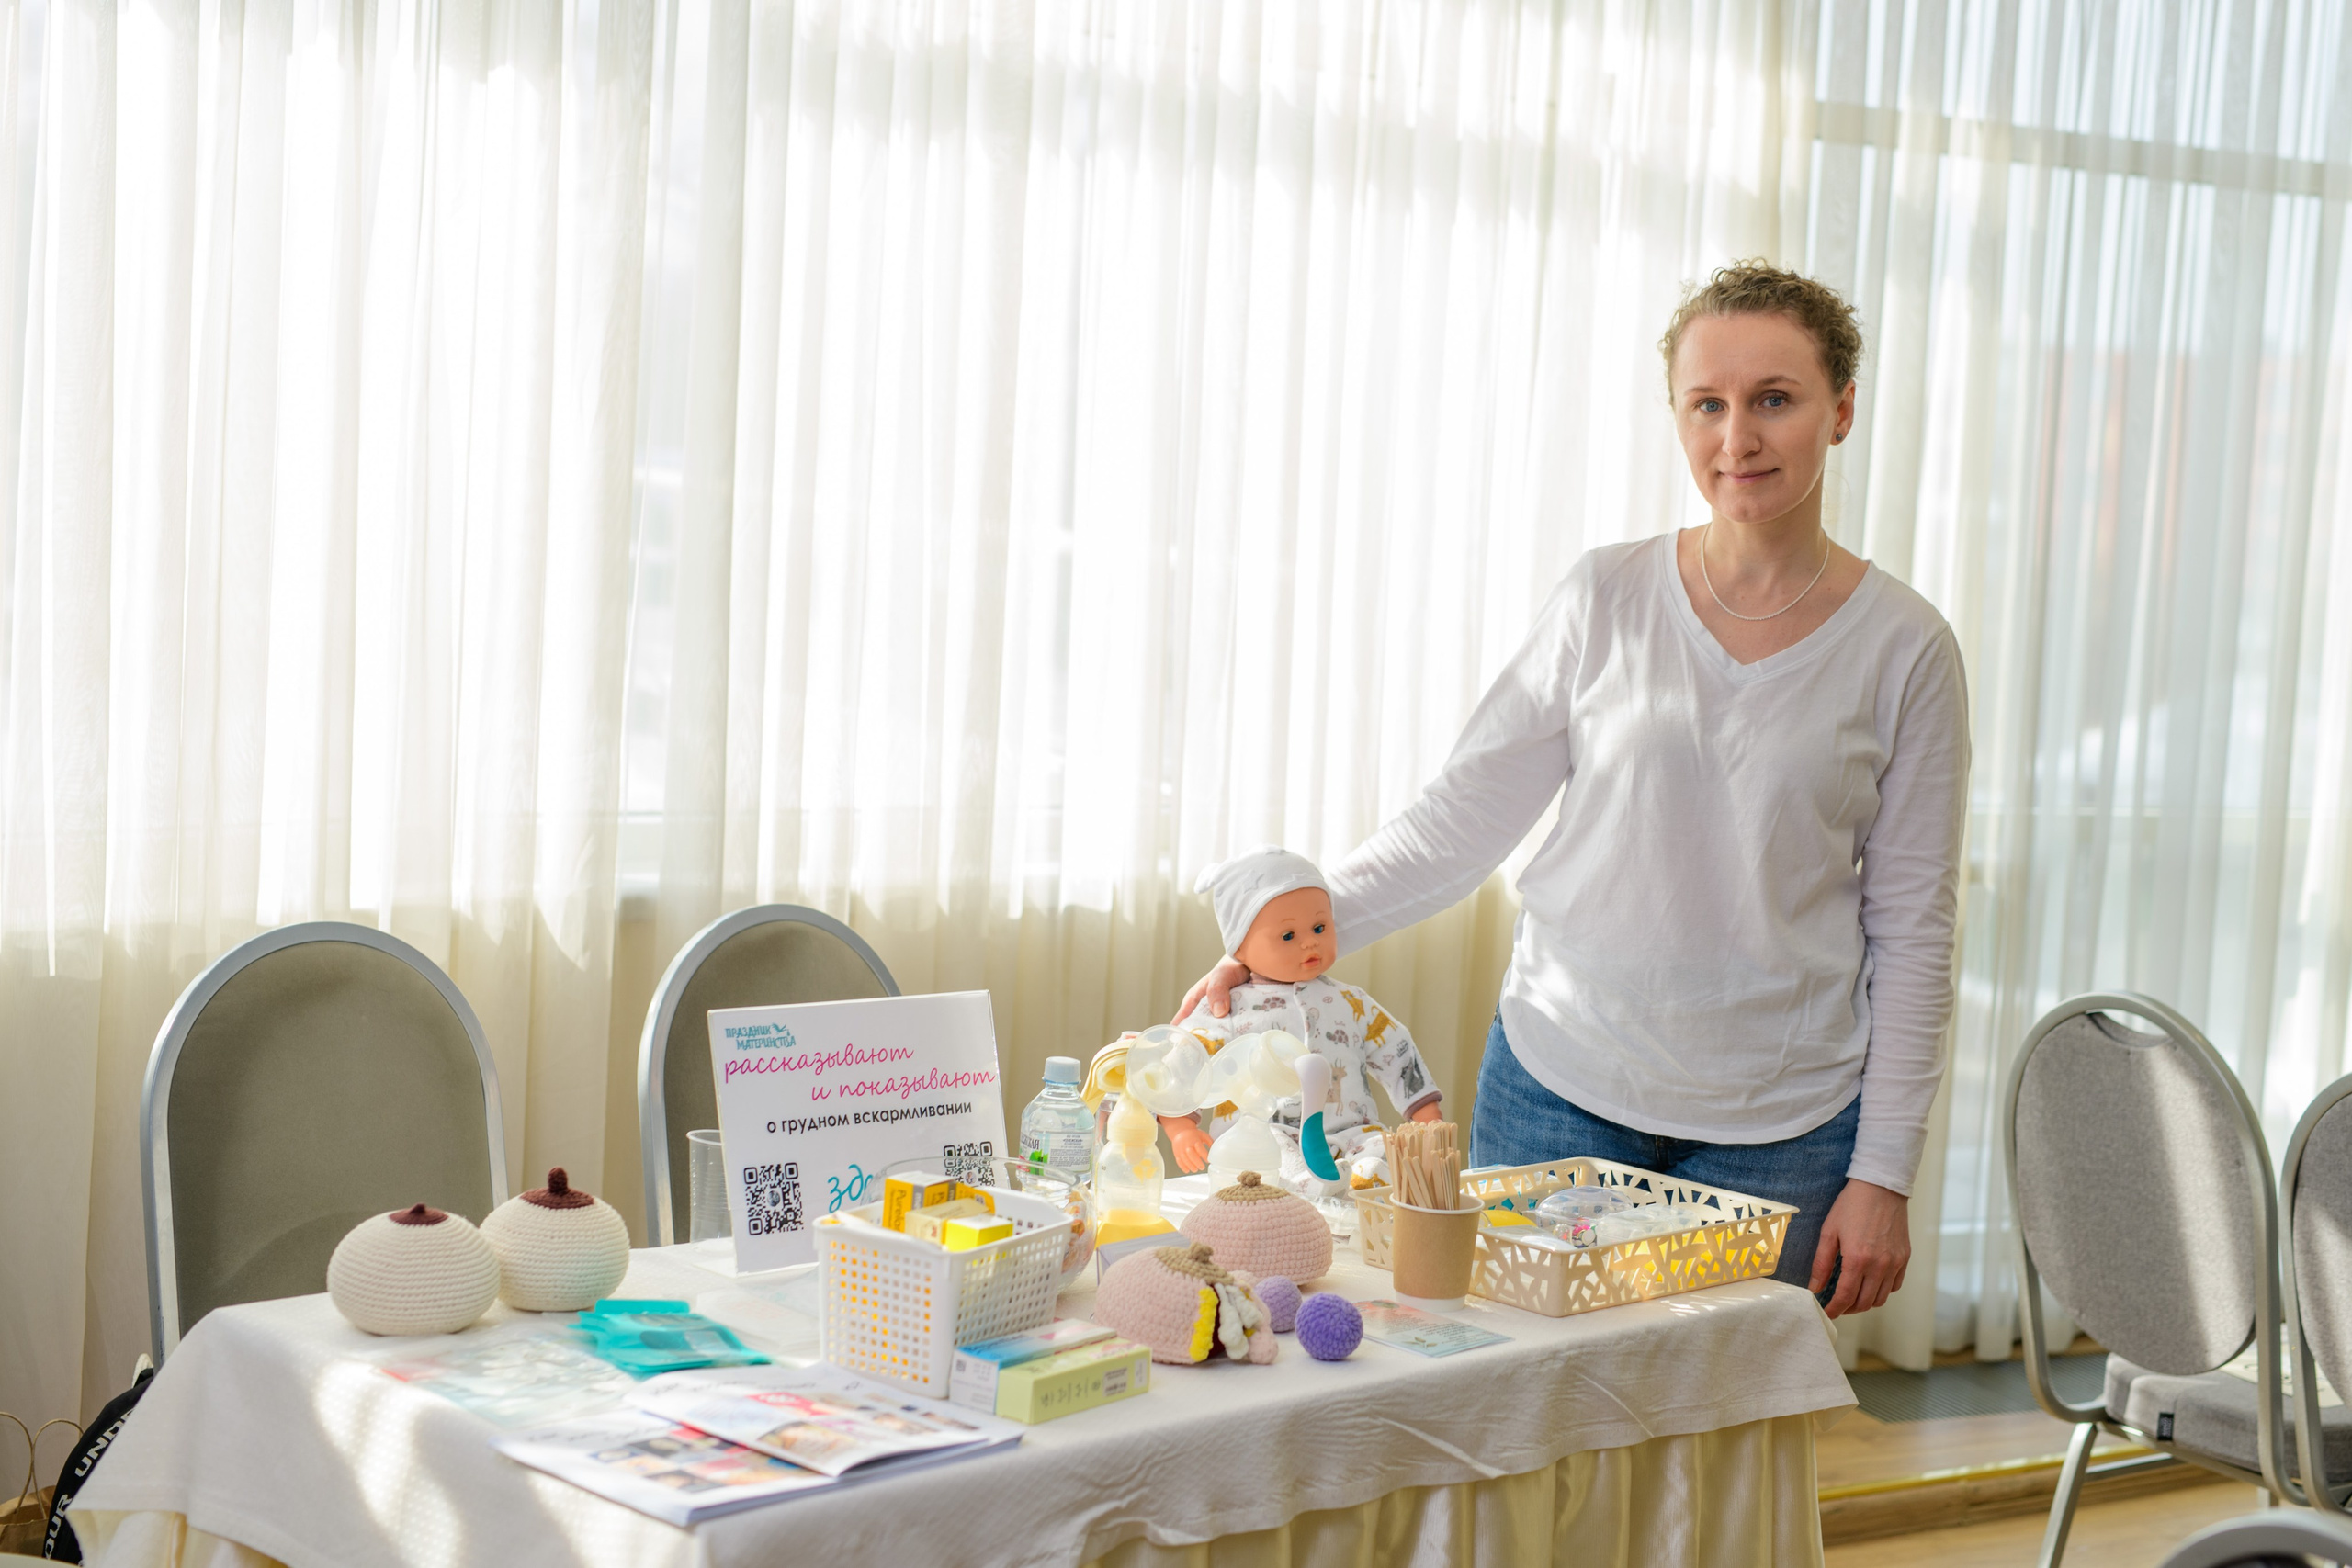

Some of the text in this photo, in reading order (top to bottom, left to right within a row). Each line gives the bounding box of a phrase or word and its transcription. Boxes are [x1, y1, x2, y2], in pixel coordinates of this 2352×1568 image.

[725, 1025, 771, 1039] ПРАЗДНИК
[736, 1036, 796, 1050] МАТЕРИНСТВА
[725, 1043, 914, 1084] рассказывают
[811, 1067, 996, 1101] и показывают
[766, 1102, 972, 1135] о грудном вскармливании
